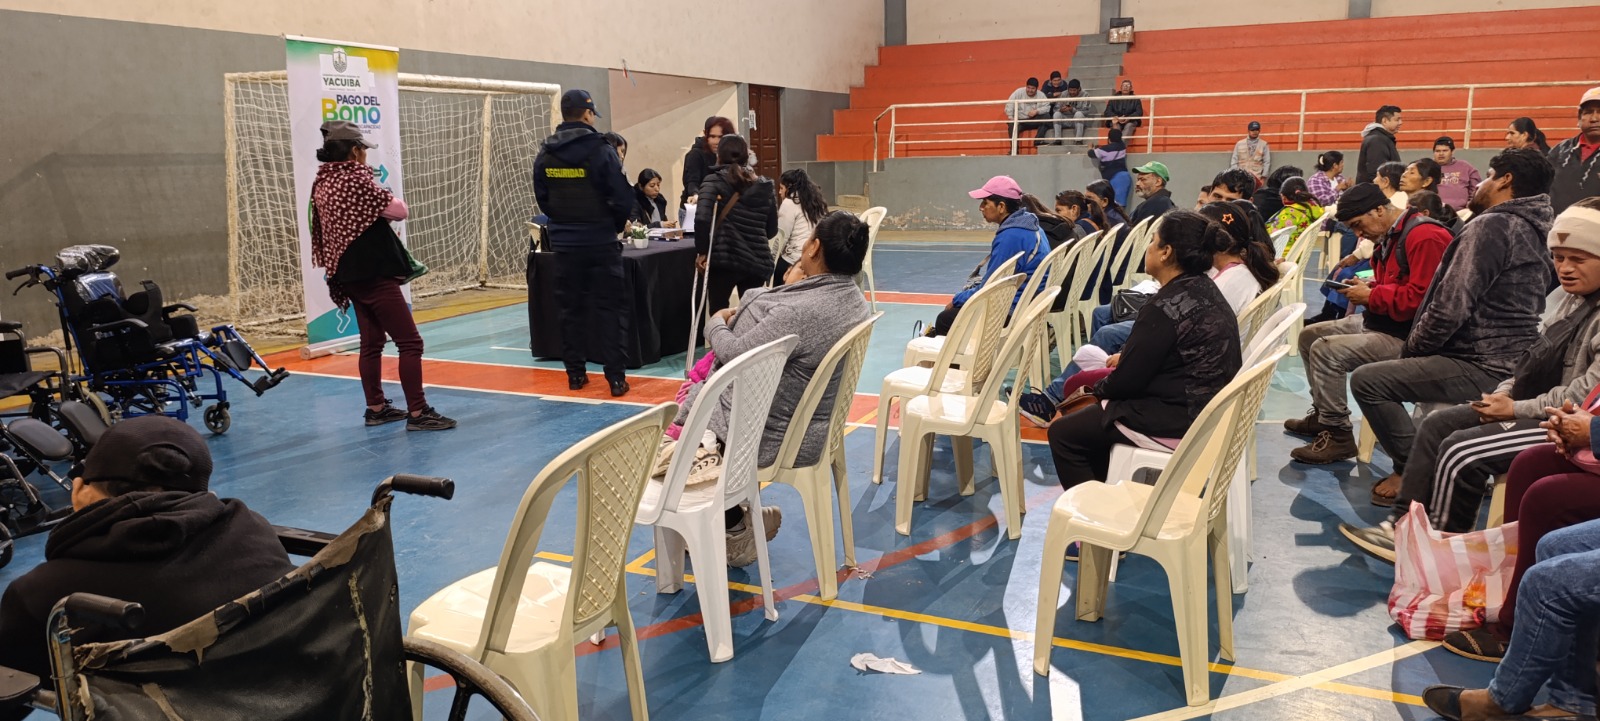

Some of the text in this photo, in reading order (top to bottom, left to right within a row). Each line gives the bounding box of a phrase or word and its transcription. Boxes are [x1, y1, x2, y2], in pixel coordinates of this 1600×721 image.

[323, 77, 361, 87] YACUIBA
[336, 94, 380, 106] PAGO DEL
[322, 98, 381, 124] Bono
[545, 168, 585, 178] SEGURIDAD
